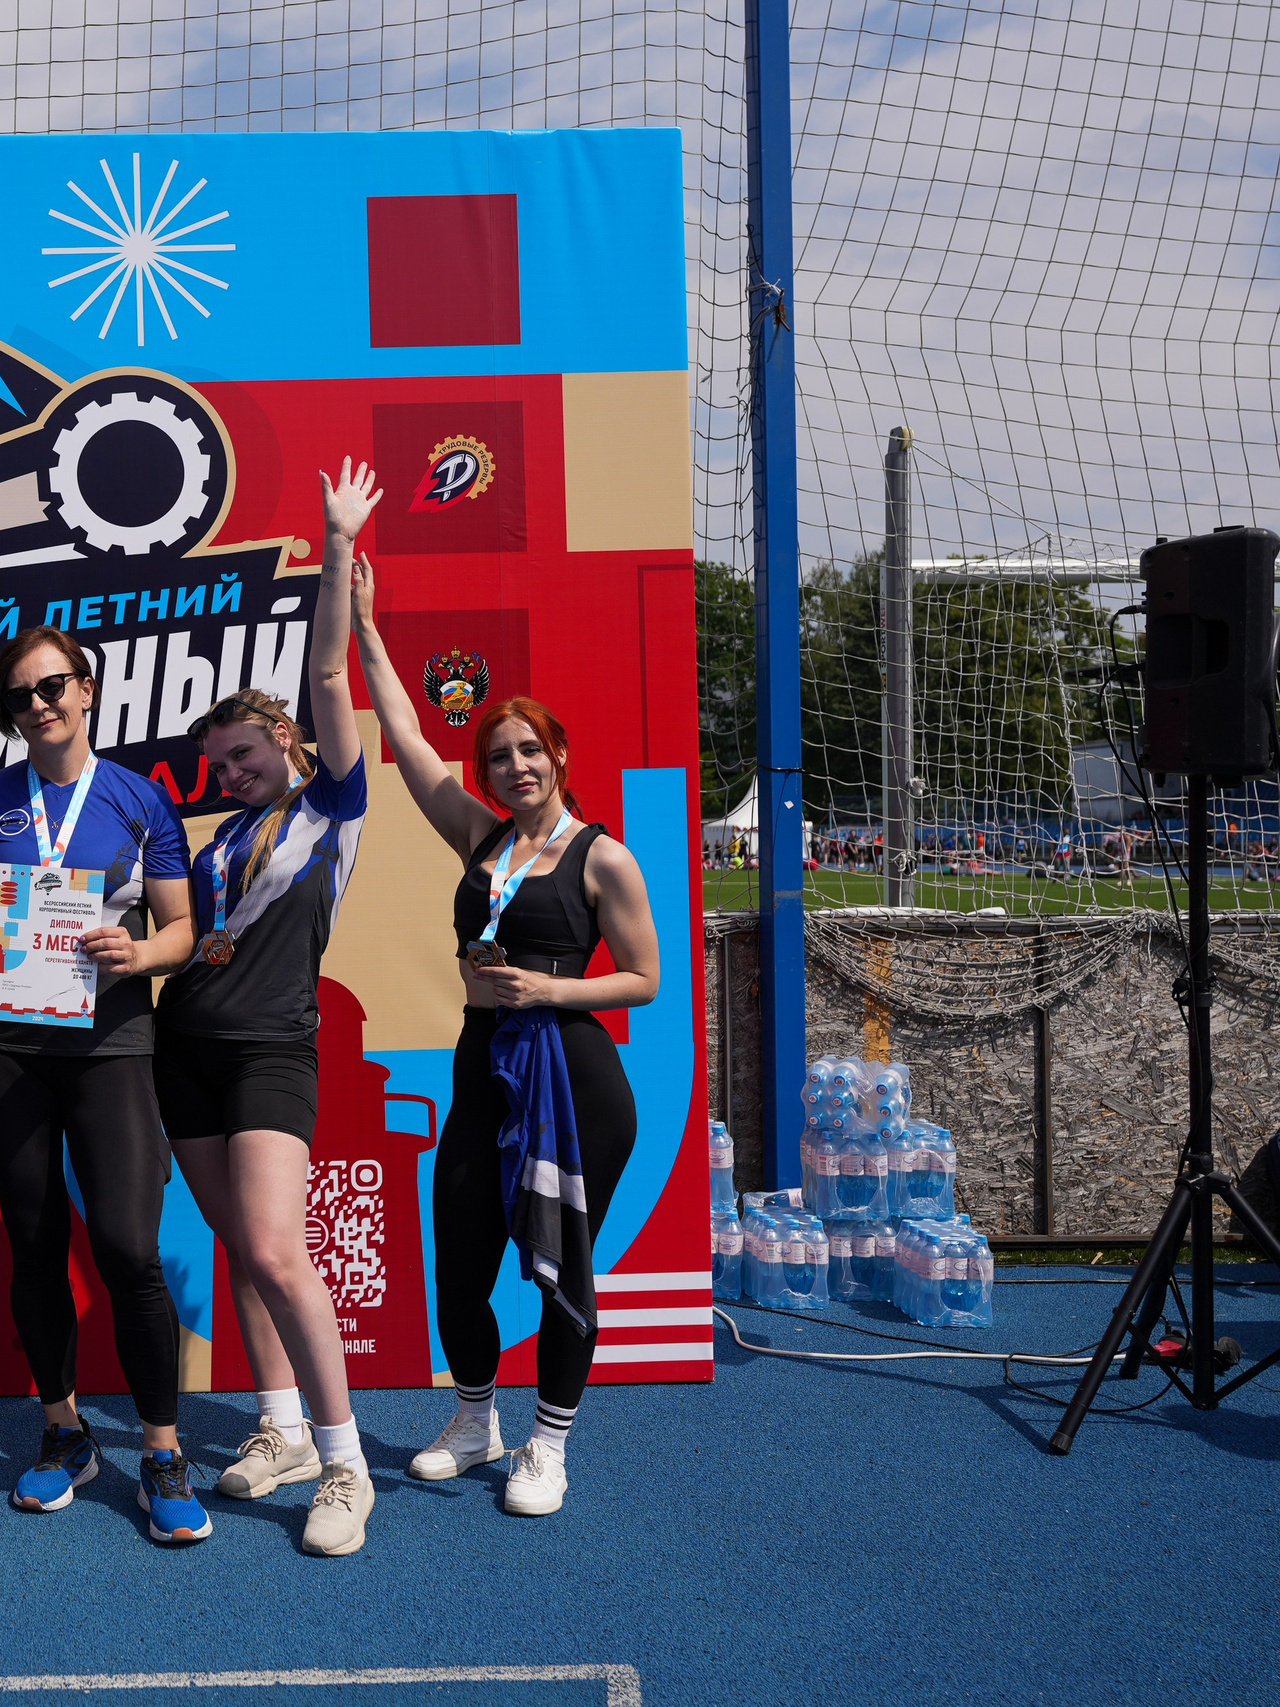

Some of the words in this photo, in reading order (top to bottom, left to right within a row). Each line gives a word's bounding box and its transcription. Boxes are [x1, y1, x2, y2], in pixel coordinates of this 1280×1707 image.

[438, 440, 479, 456] ТРУДОВЫЕ
[477, 450, 489, 485] РЕЗЕРВЫ
[44, 573, 243, 632] ЛЕТНИЙ
[43, 900, 77, 908] ВСЕРОССИЙСКИЙ
[49, 919, 83, 930] ДИПЛОМ
[32, 933, 42, 950] 3
[45, 934, 80, 953] МЕС
[341, 1339, 377, 1354] НАЛЕ
